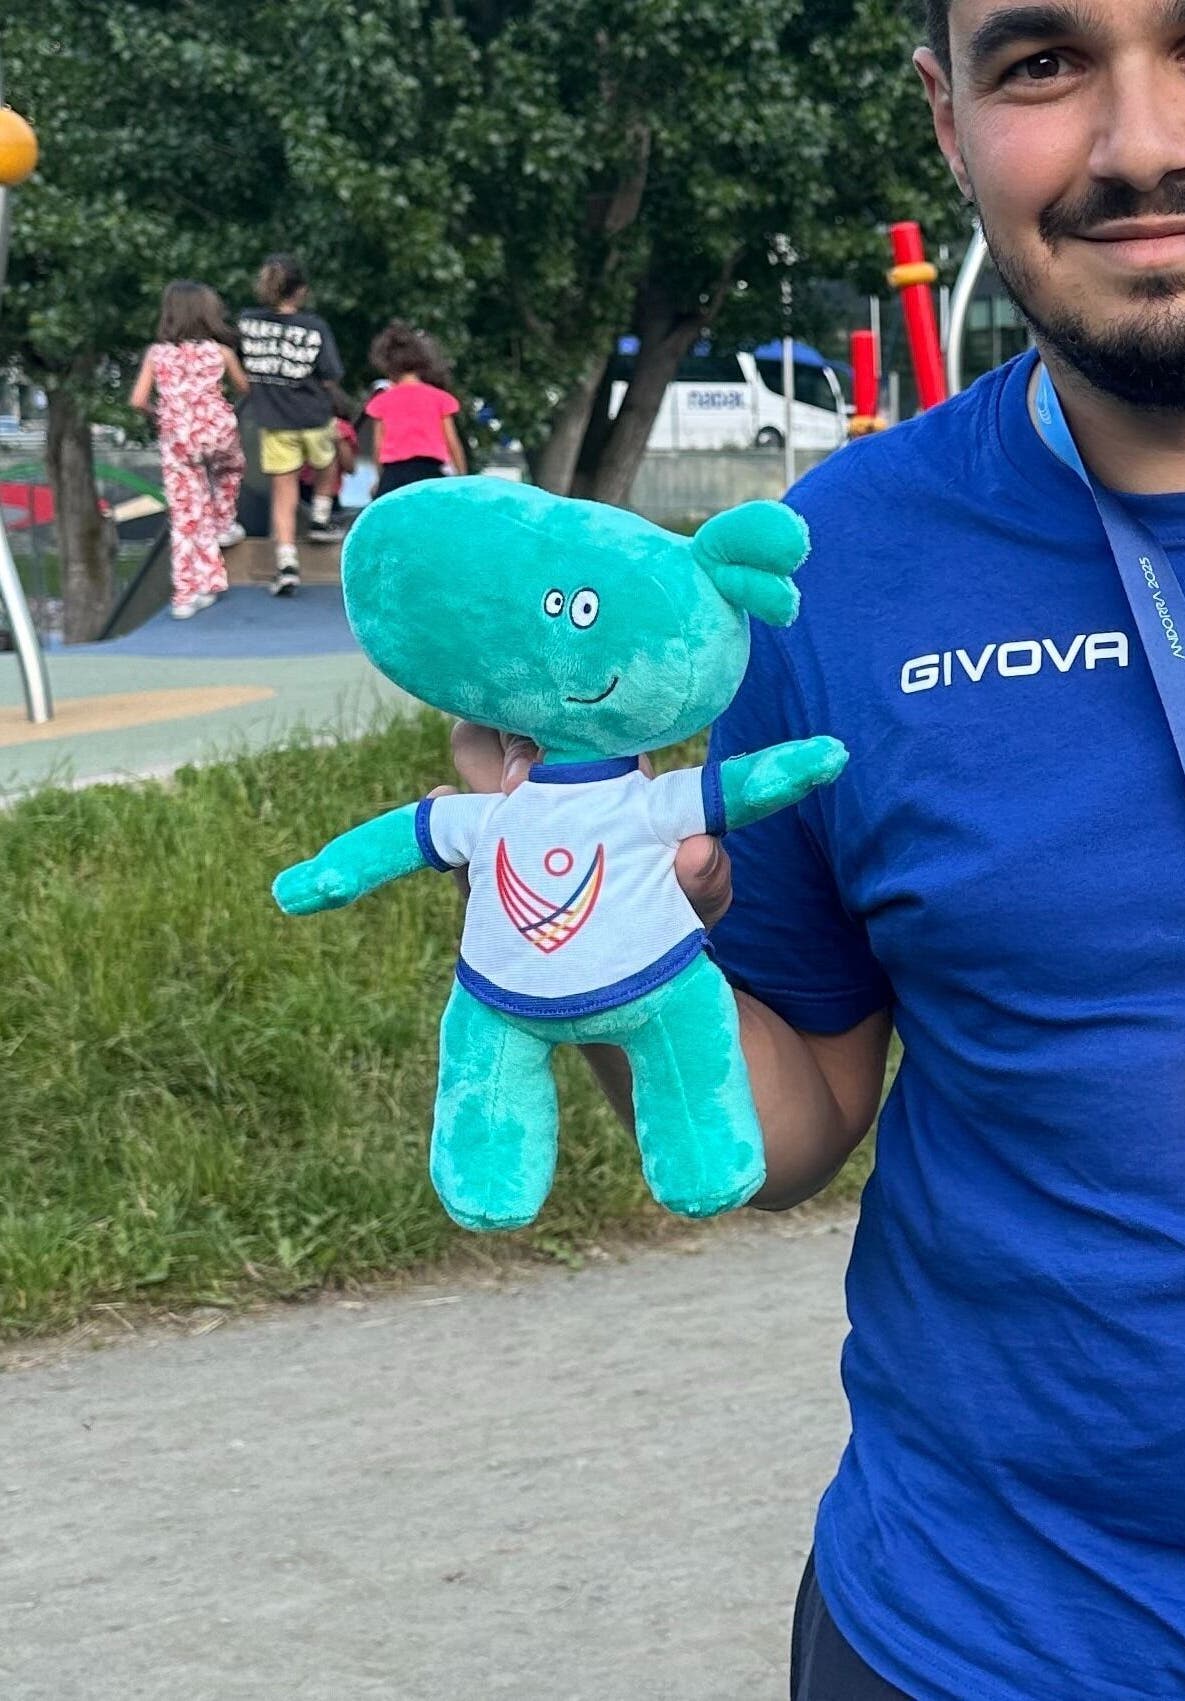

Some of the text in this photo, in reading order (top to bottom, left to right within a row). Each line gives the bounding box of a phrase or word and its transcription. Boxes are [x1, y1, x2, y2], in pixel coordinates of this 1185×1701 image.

[1138, 556, 1185, 659] ANDORRA 2025
[900, 631, 1129, 694] GIVOVA
